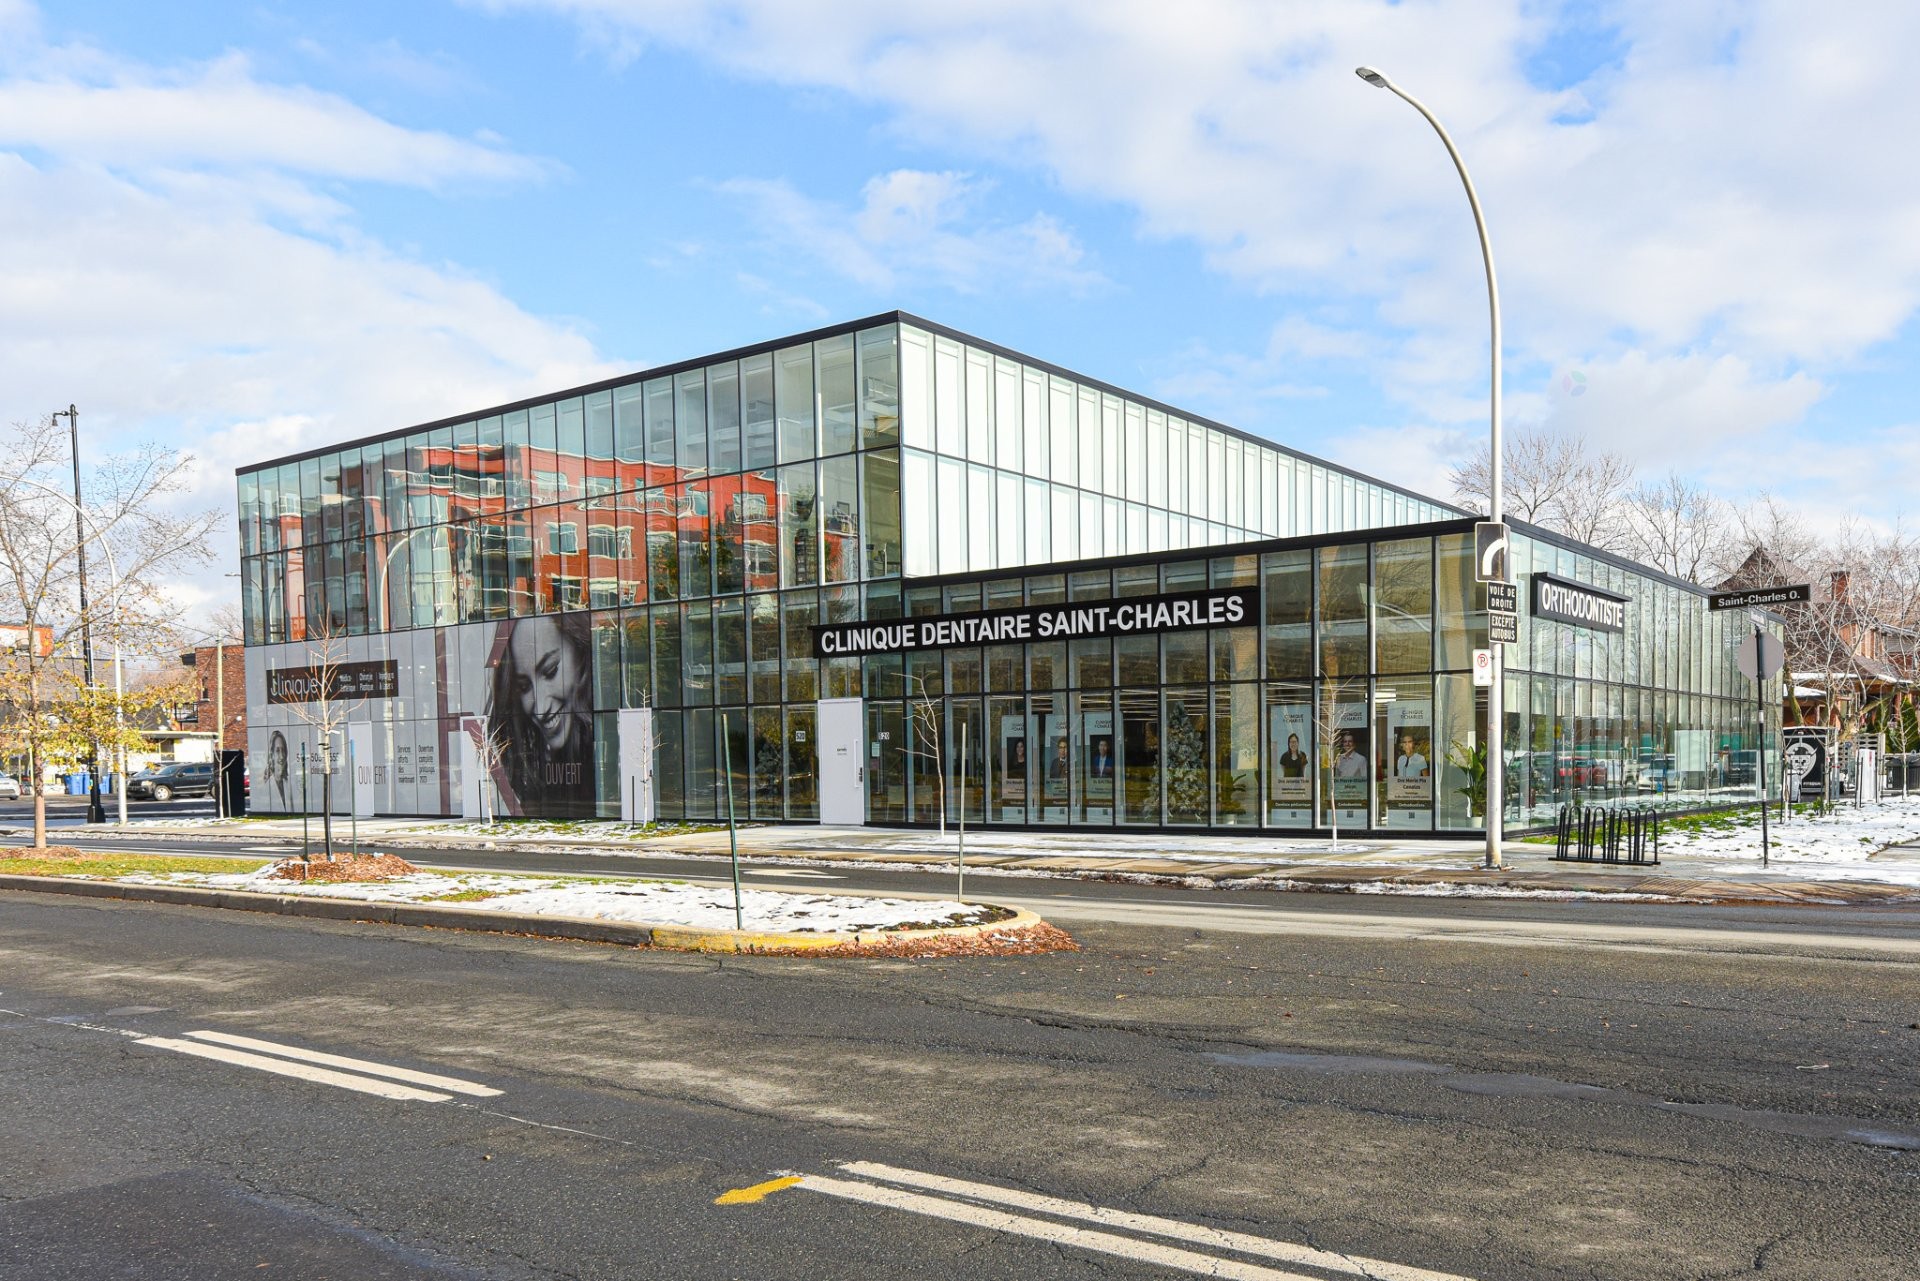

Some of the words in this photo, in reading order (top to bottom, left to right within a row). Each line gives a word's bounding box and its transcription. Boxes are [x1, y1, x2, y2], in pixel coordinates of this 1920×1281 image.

[1489, 585, 1505, 597] VOIE
[1507, 588, 1515, 598] DE
[1717, 592, 1787, 607] Saint-Charles
[1789, 590, 1801, 600] O.
[1491, 597, 1513, 609] DROITE
[1541, 582, 1623, 628] ORTHODONTISTE
[821, 625, 916, 653] CLINIQUE
[922, 614, 1032, 646] DENTAIRE
[1038, 596, 1245, 637] SAINT-CHARLES
[1491, 628, 1516, 641] AUTOBUS
[546, 762, 582, 785] OUVERT
